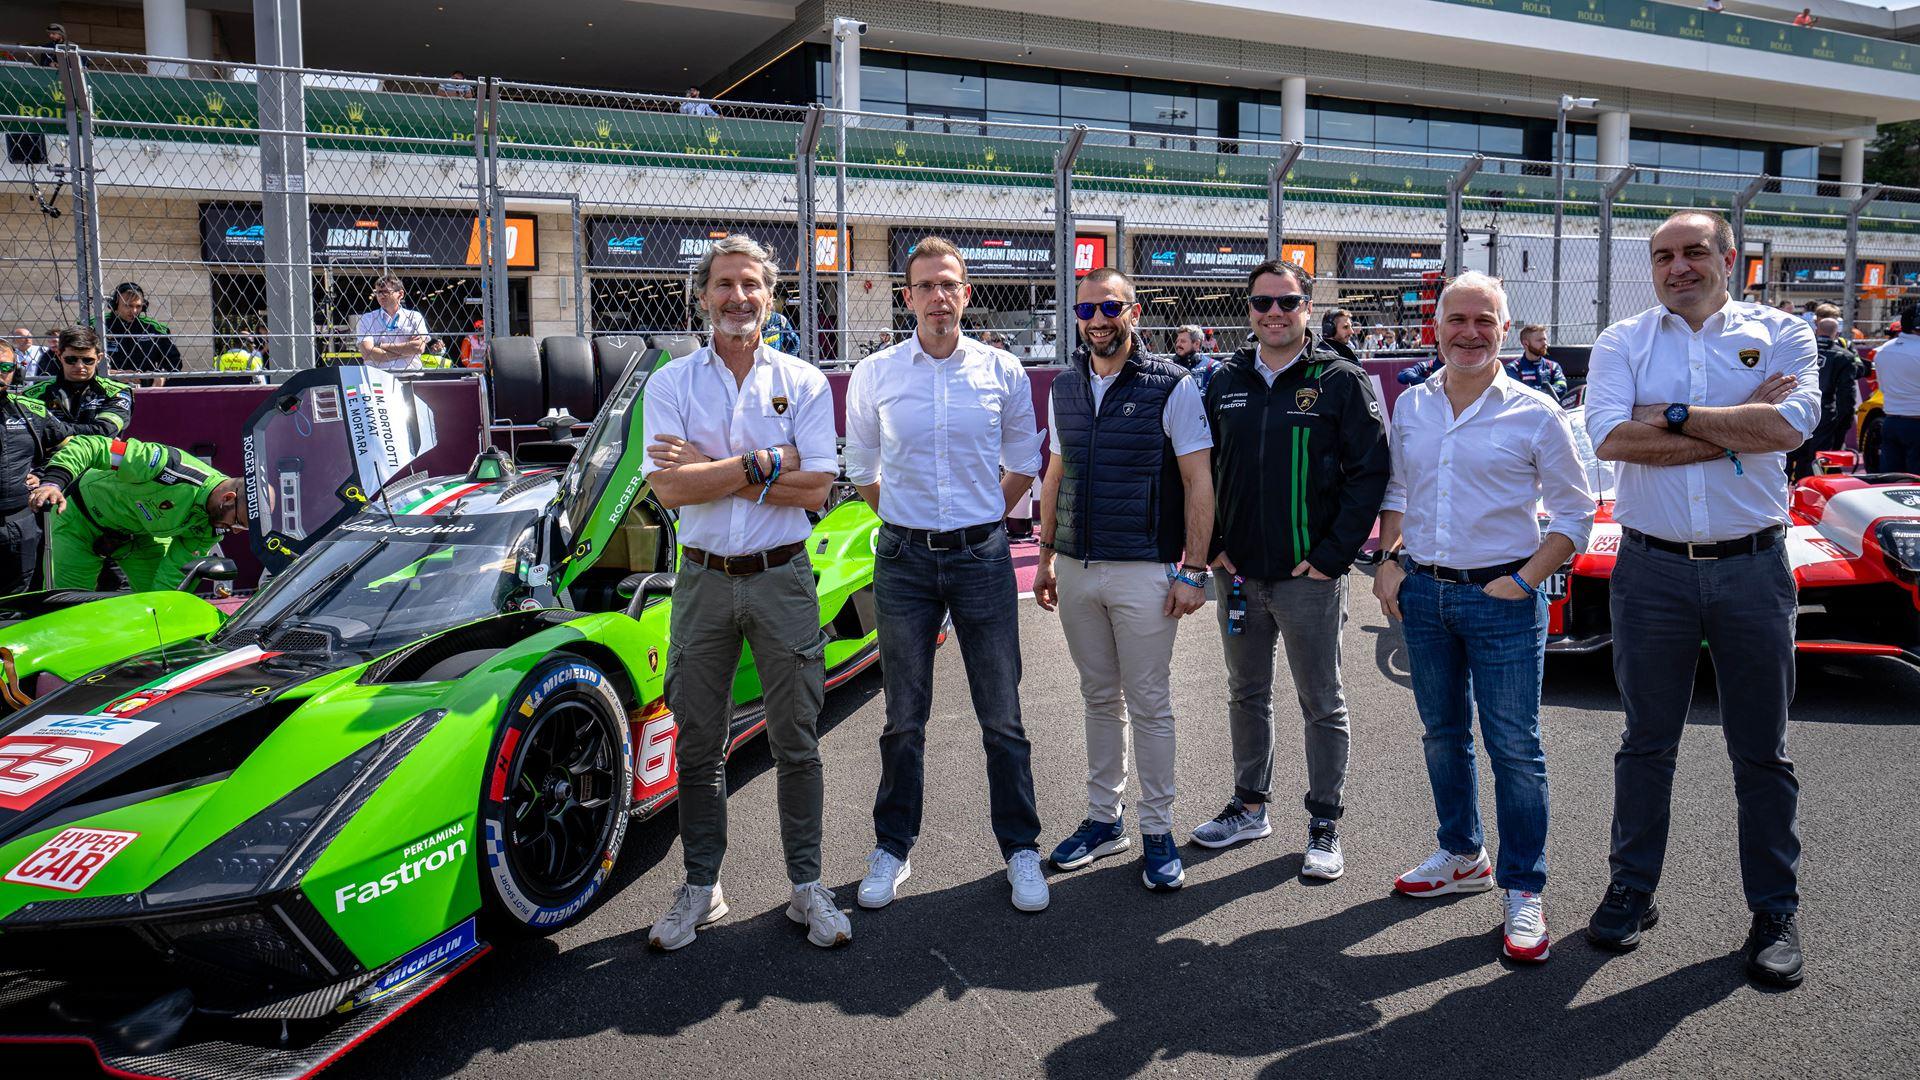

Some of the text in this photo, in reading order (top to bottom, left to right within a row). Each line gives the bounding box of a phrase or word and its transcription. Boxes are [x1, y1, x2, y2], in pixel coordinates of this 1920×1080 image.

[1522, 2, 1551, 15] ROLEX
[1577, 10, 1605, 23] ROLEX
[1630, 19, 1656, 31] ROLEX
[1679, 26, 1704, 38] ROLEX
[176, 115, 253, 129] ROLEX
[320, 124, 391, 138] ROLEX
[452, 132, 518, 147] ROLX
[573, 140, 634, 152] ROLEX
[685, 146, 742, 159] ROLEX
[877, 158, 926, 169] ROLEX
[326, 228, 411, 249] IRON LYNX
[958, 247, 1051, 262] BORGHINI IRON LYNX
[1075, 244, 1095, 270] 63
[1185, 252, 1215, 265] PROTON
[1216, 253, 1266, 267] COMPETITION
[1382, 257, 1408, 269] PROTON
[1408, 258, 1444, 270] COMPETITI
[1219, 402, 1247, 410] Fastron
[361, 395, 379, 437] D. KVYAT
[348, 397, 369, 456] E. MORTARA
[375, 395, 399, 467] M. BORTOLOTTI
[243, 435, 259, 520] ROGER DUBUIS
[608, 474, 640, 524] ROGER
[339, 519, 476, 536] Lamborghini
[1593, 542, 1618, 552] CA
[542, 667, 597, 695] MICHELIN
[602, 681, 627, 726] PILOT SPORT
[47, 717, 133, 731] WEC
[634, 711, 679, 788] 6
[48, 831, 128, 853] HYPER
[403, 822, 465, 859] PERTAMINA
[16, 848, 105, 885] CAR
[335, 838, 467, 914] Fastron
[499, 873, 531, 915] PILOT SPORT
[535, 883, 596, 924] MICHELIN
[384, 934, 463, 987] MICHELIN
